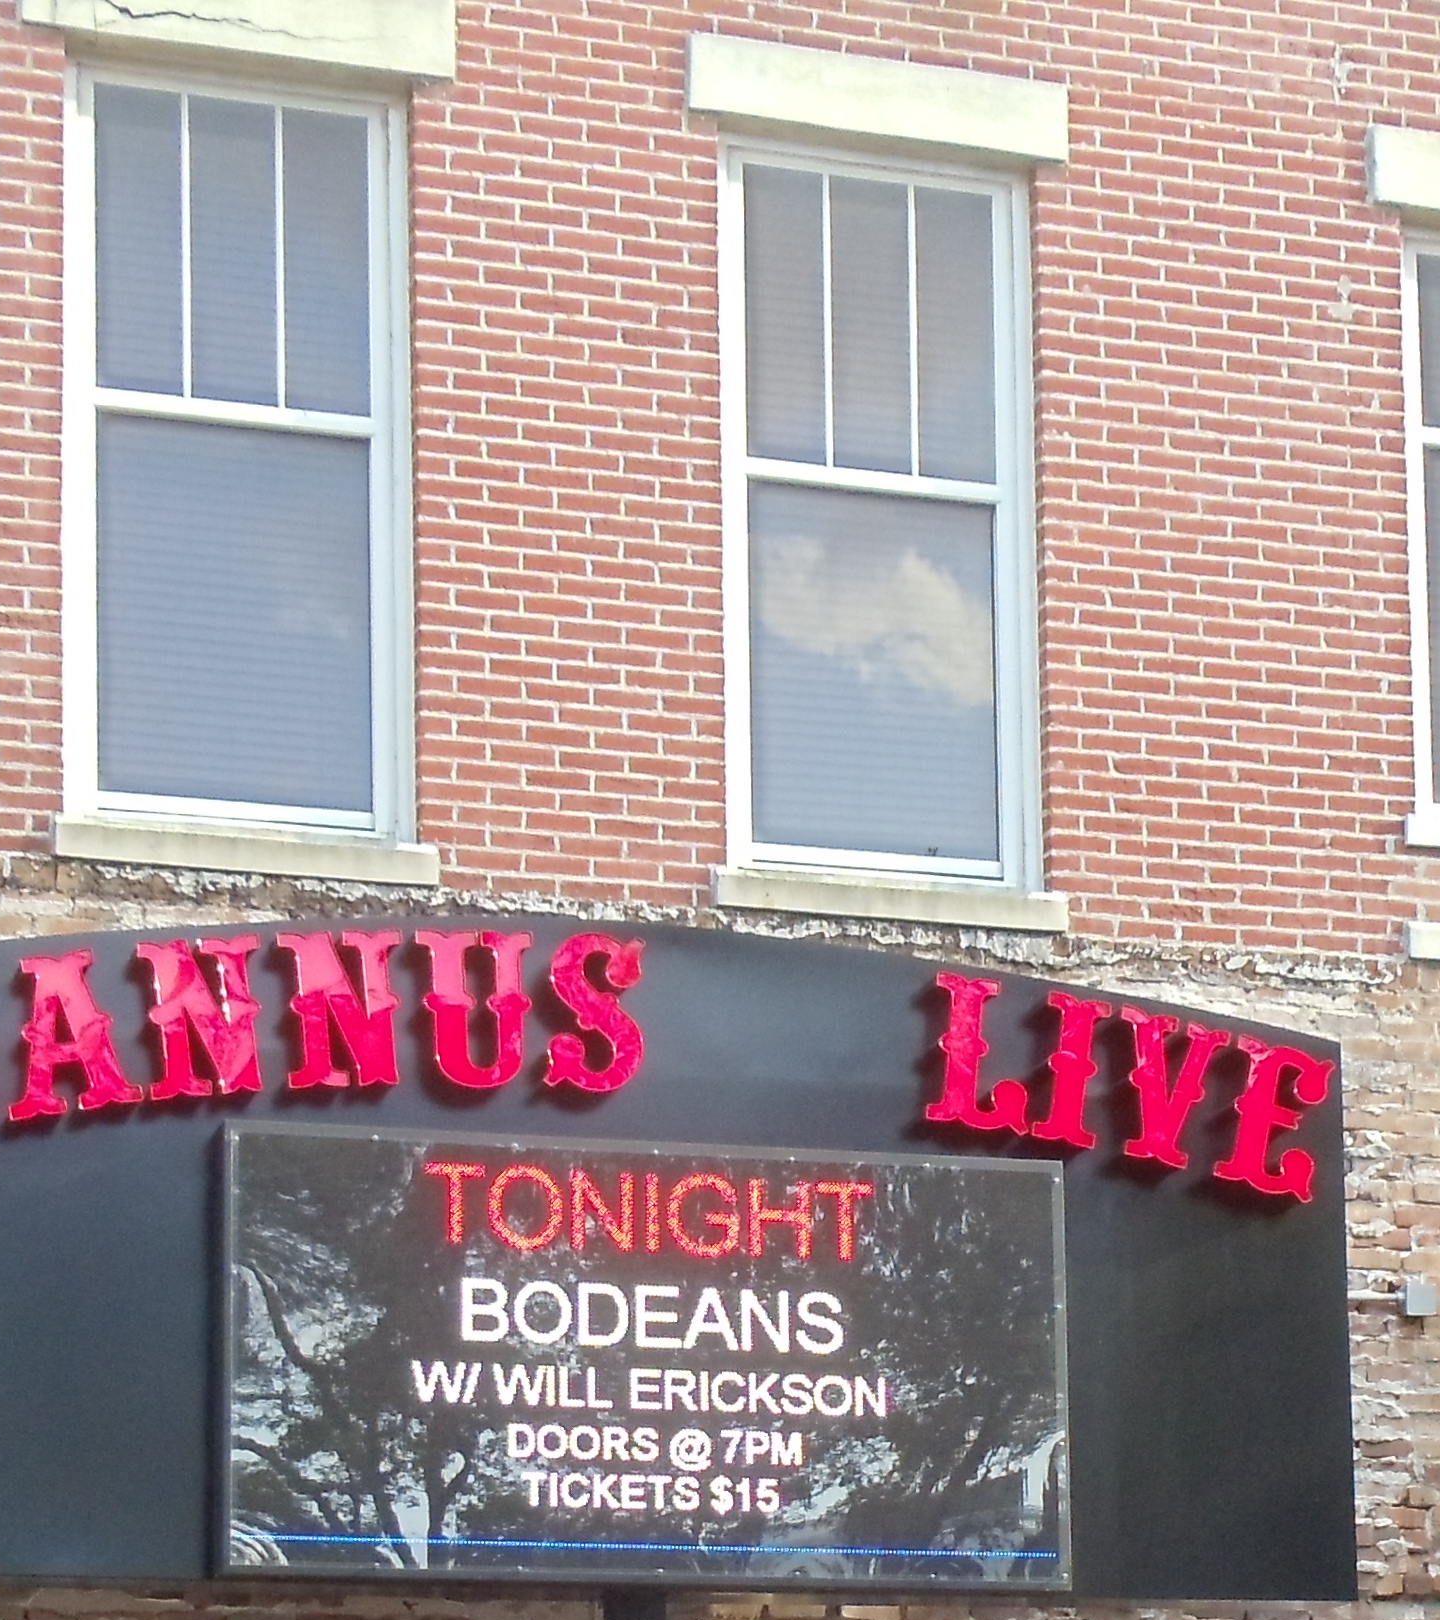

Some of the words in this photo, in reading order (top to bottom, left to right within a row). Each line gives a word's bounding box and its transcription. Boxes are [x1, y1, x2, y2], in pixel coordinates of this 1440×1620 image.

[926, 971, 1335, 1203] LIVE
[424, 1161, 874, 1263] TONIGHT
[461, 1277, 846, 1356] BODEANS
[410, 1359, 482, 1404] W/
[492, 1363, 614, 1409] WILL
[629, 1367, 888, 1418] ERICKSON
[506, 1422, 660, 1462] DOORS
[669, 1428, 713, 1472] @
[720, 1430, 803, 1467] 7PM
[520, 1471, 701, 1511] TICKETS
[710, 1476, 781, 1517] $15
